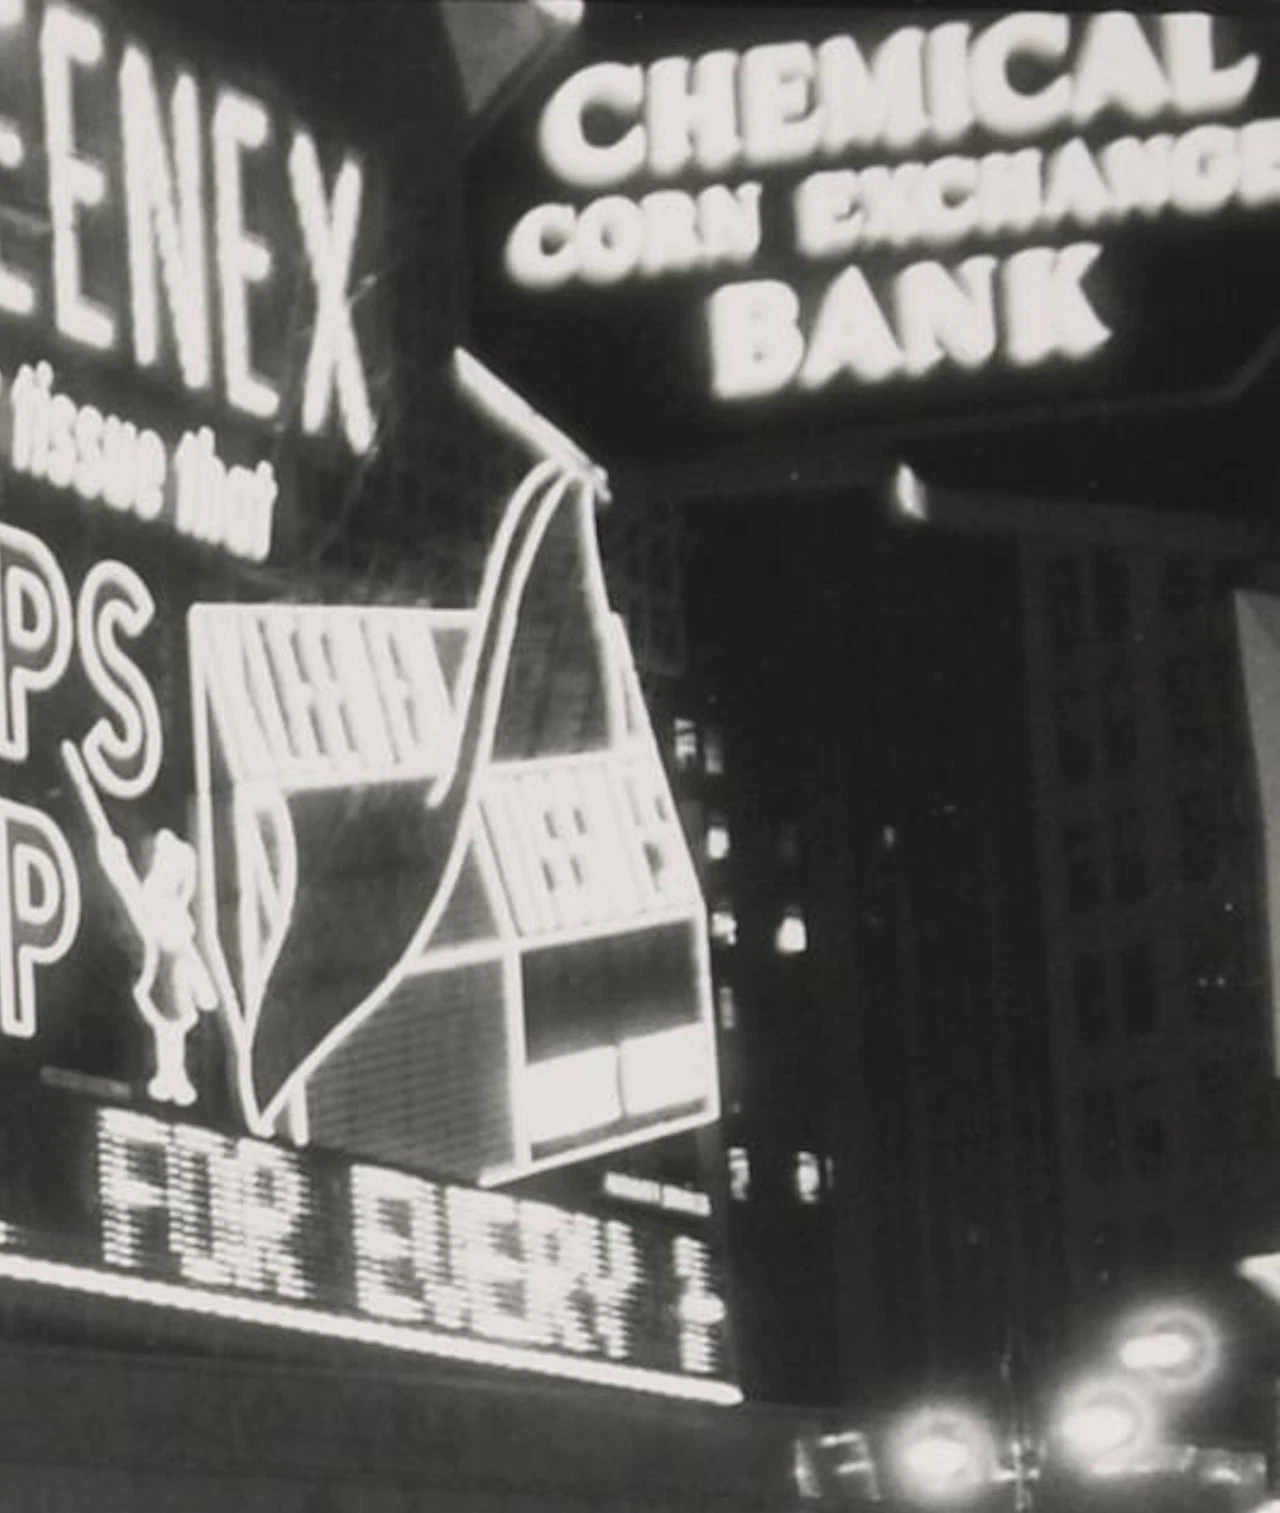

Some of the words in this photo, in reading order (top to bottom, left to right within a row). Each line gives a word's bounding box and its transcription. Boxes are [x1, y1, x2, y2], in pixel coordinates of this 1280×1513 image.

[538, 10, 1260, 187] CHEMICAL
[506, 182, 763, 288] CORN
[796, 118, 1280, 258] EXCHANGE
[707, 242, 1112, 399] BANK
[175, 427, 278, 562] that
[98, 1107, 312, 1300] FOR
